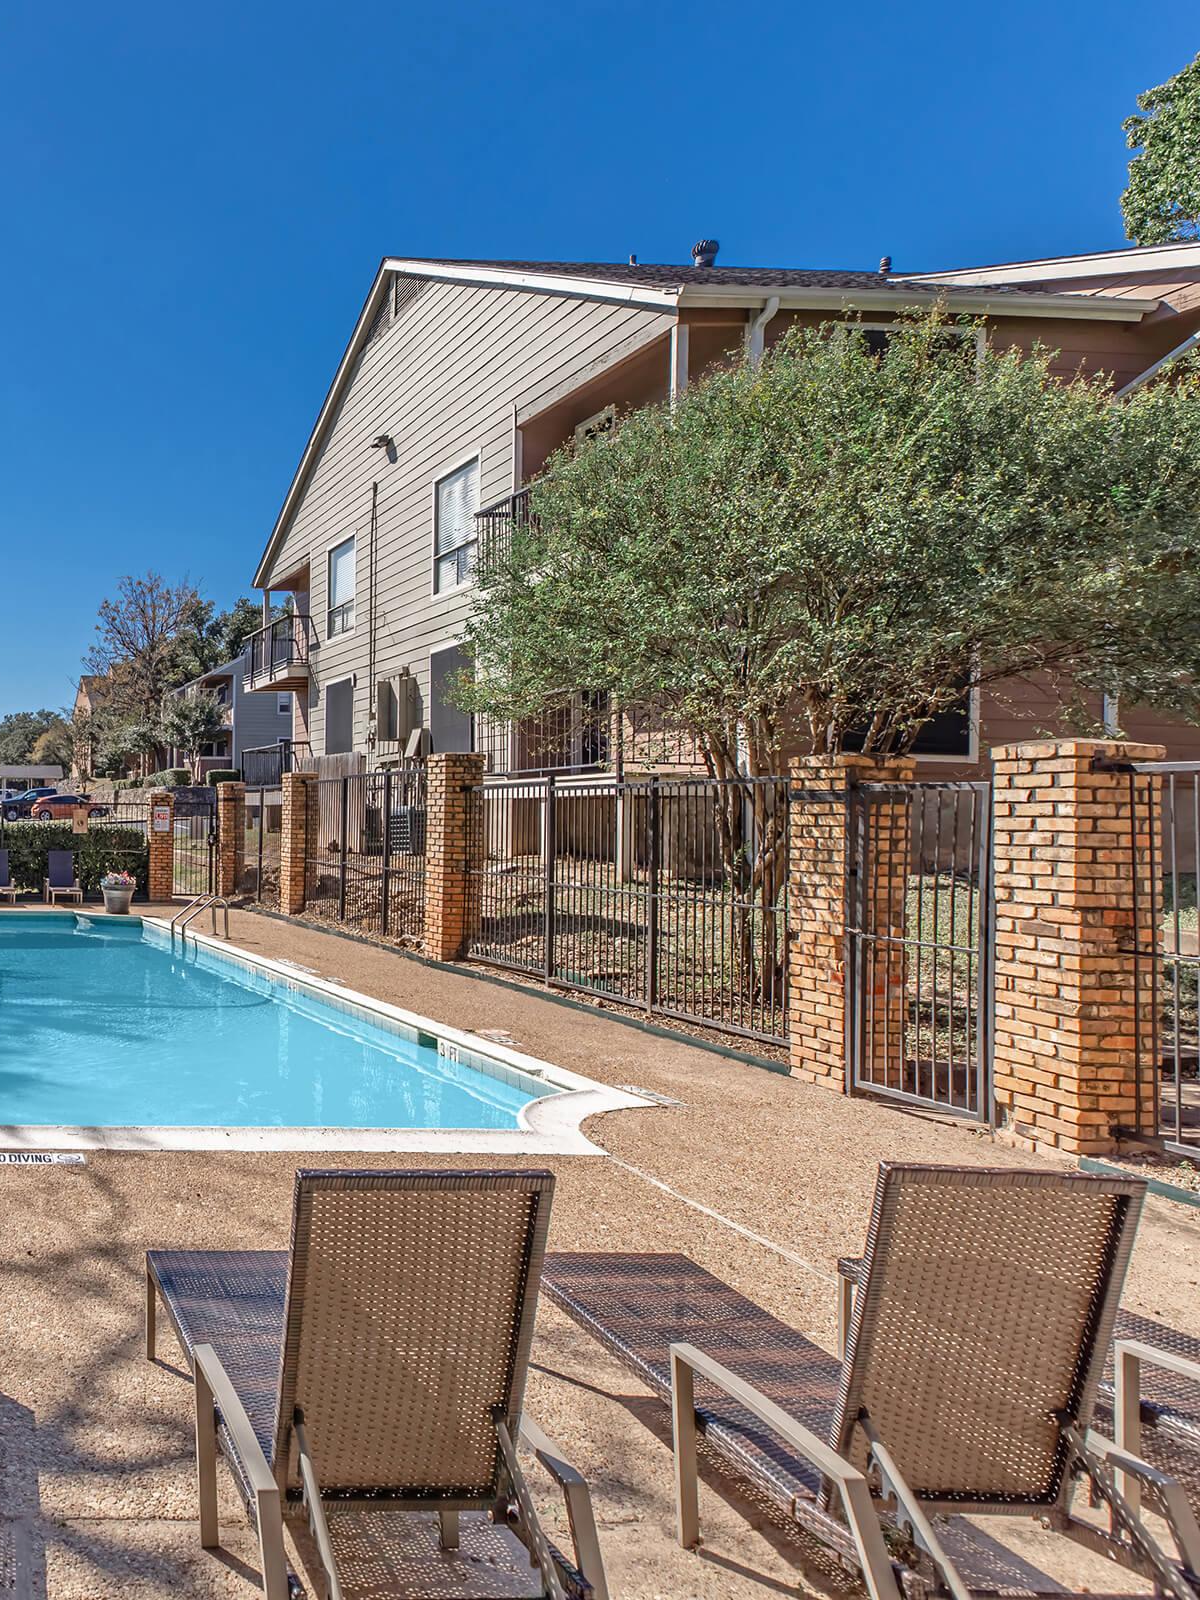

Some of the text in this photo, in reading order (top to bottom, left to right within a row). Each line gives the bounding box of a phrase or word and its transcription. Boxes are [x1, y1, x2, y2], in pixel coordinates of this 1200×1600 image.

[440, 1042, 457, 1062] 3 FT
[8, 1154, 52, 1163] DIVING
